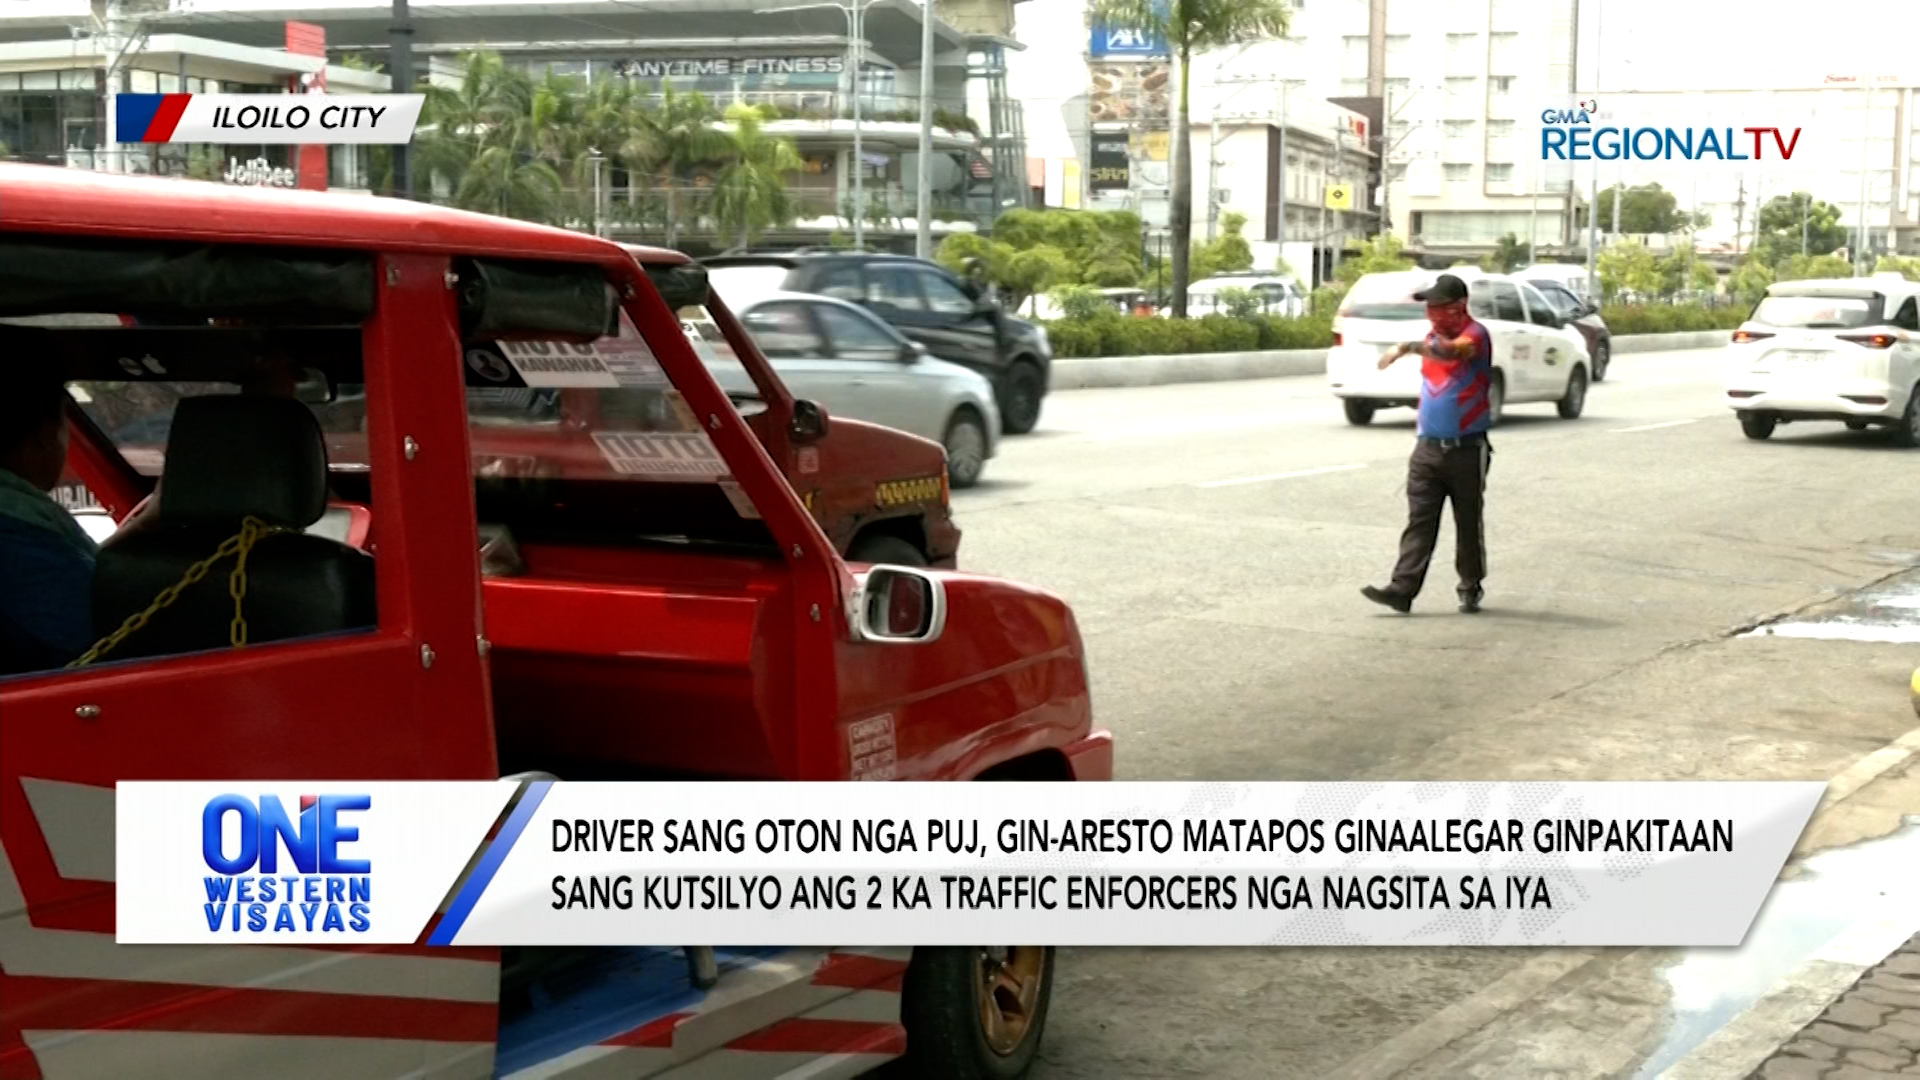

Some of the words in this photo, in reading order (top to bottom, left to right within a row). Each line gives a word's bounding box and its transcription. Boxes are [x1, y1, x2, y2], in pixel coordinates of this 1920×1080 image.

[628, 59, 729, 77] ANYTIME
[742, 57, 844, 74] FITNESS
[223, 156, 296, 187] Jollibee
